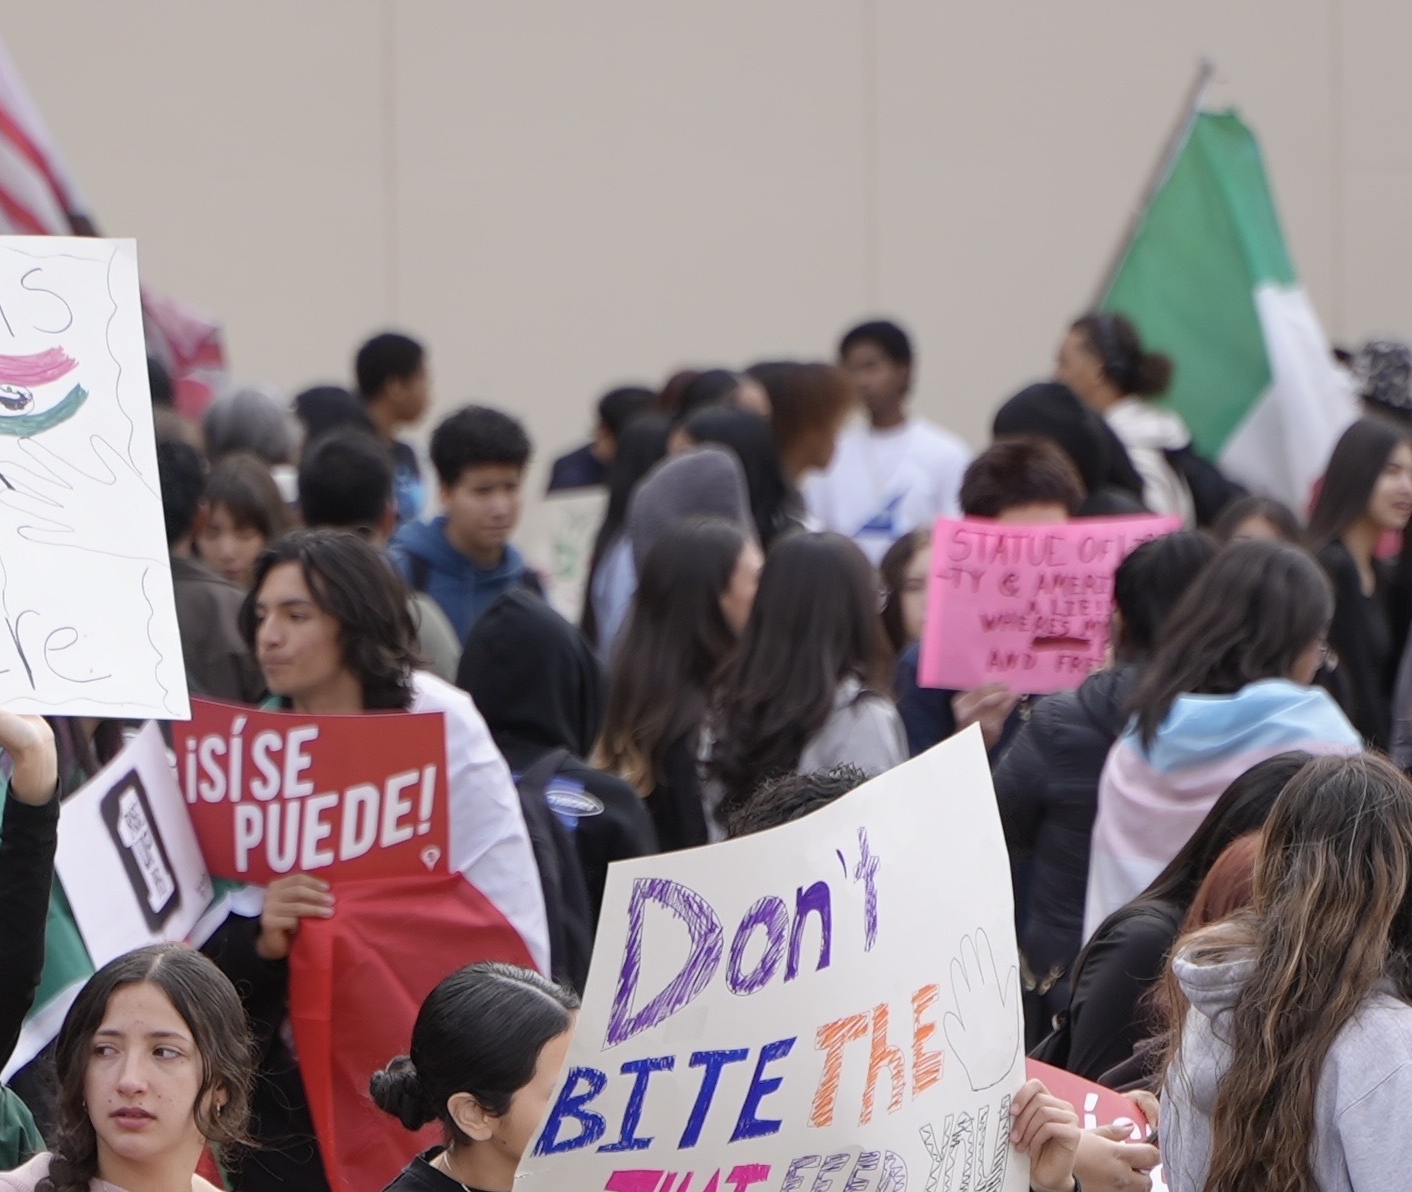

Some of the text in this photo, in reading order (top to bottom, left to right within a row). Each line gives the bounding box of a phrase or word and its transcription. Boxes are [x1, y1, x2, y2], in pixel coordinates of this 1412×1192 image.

[948, 529, 1068, 567] STATUE
[1034, 574, 1112, 597] AMERI
[251, 725, 319, 801] SE
[235, 765, 437, 873] PUEDE!
[601, 826, 880, 1051] Don't
[529, 1036, 798, 1157] BITE
